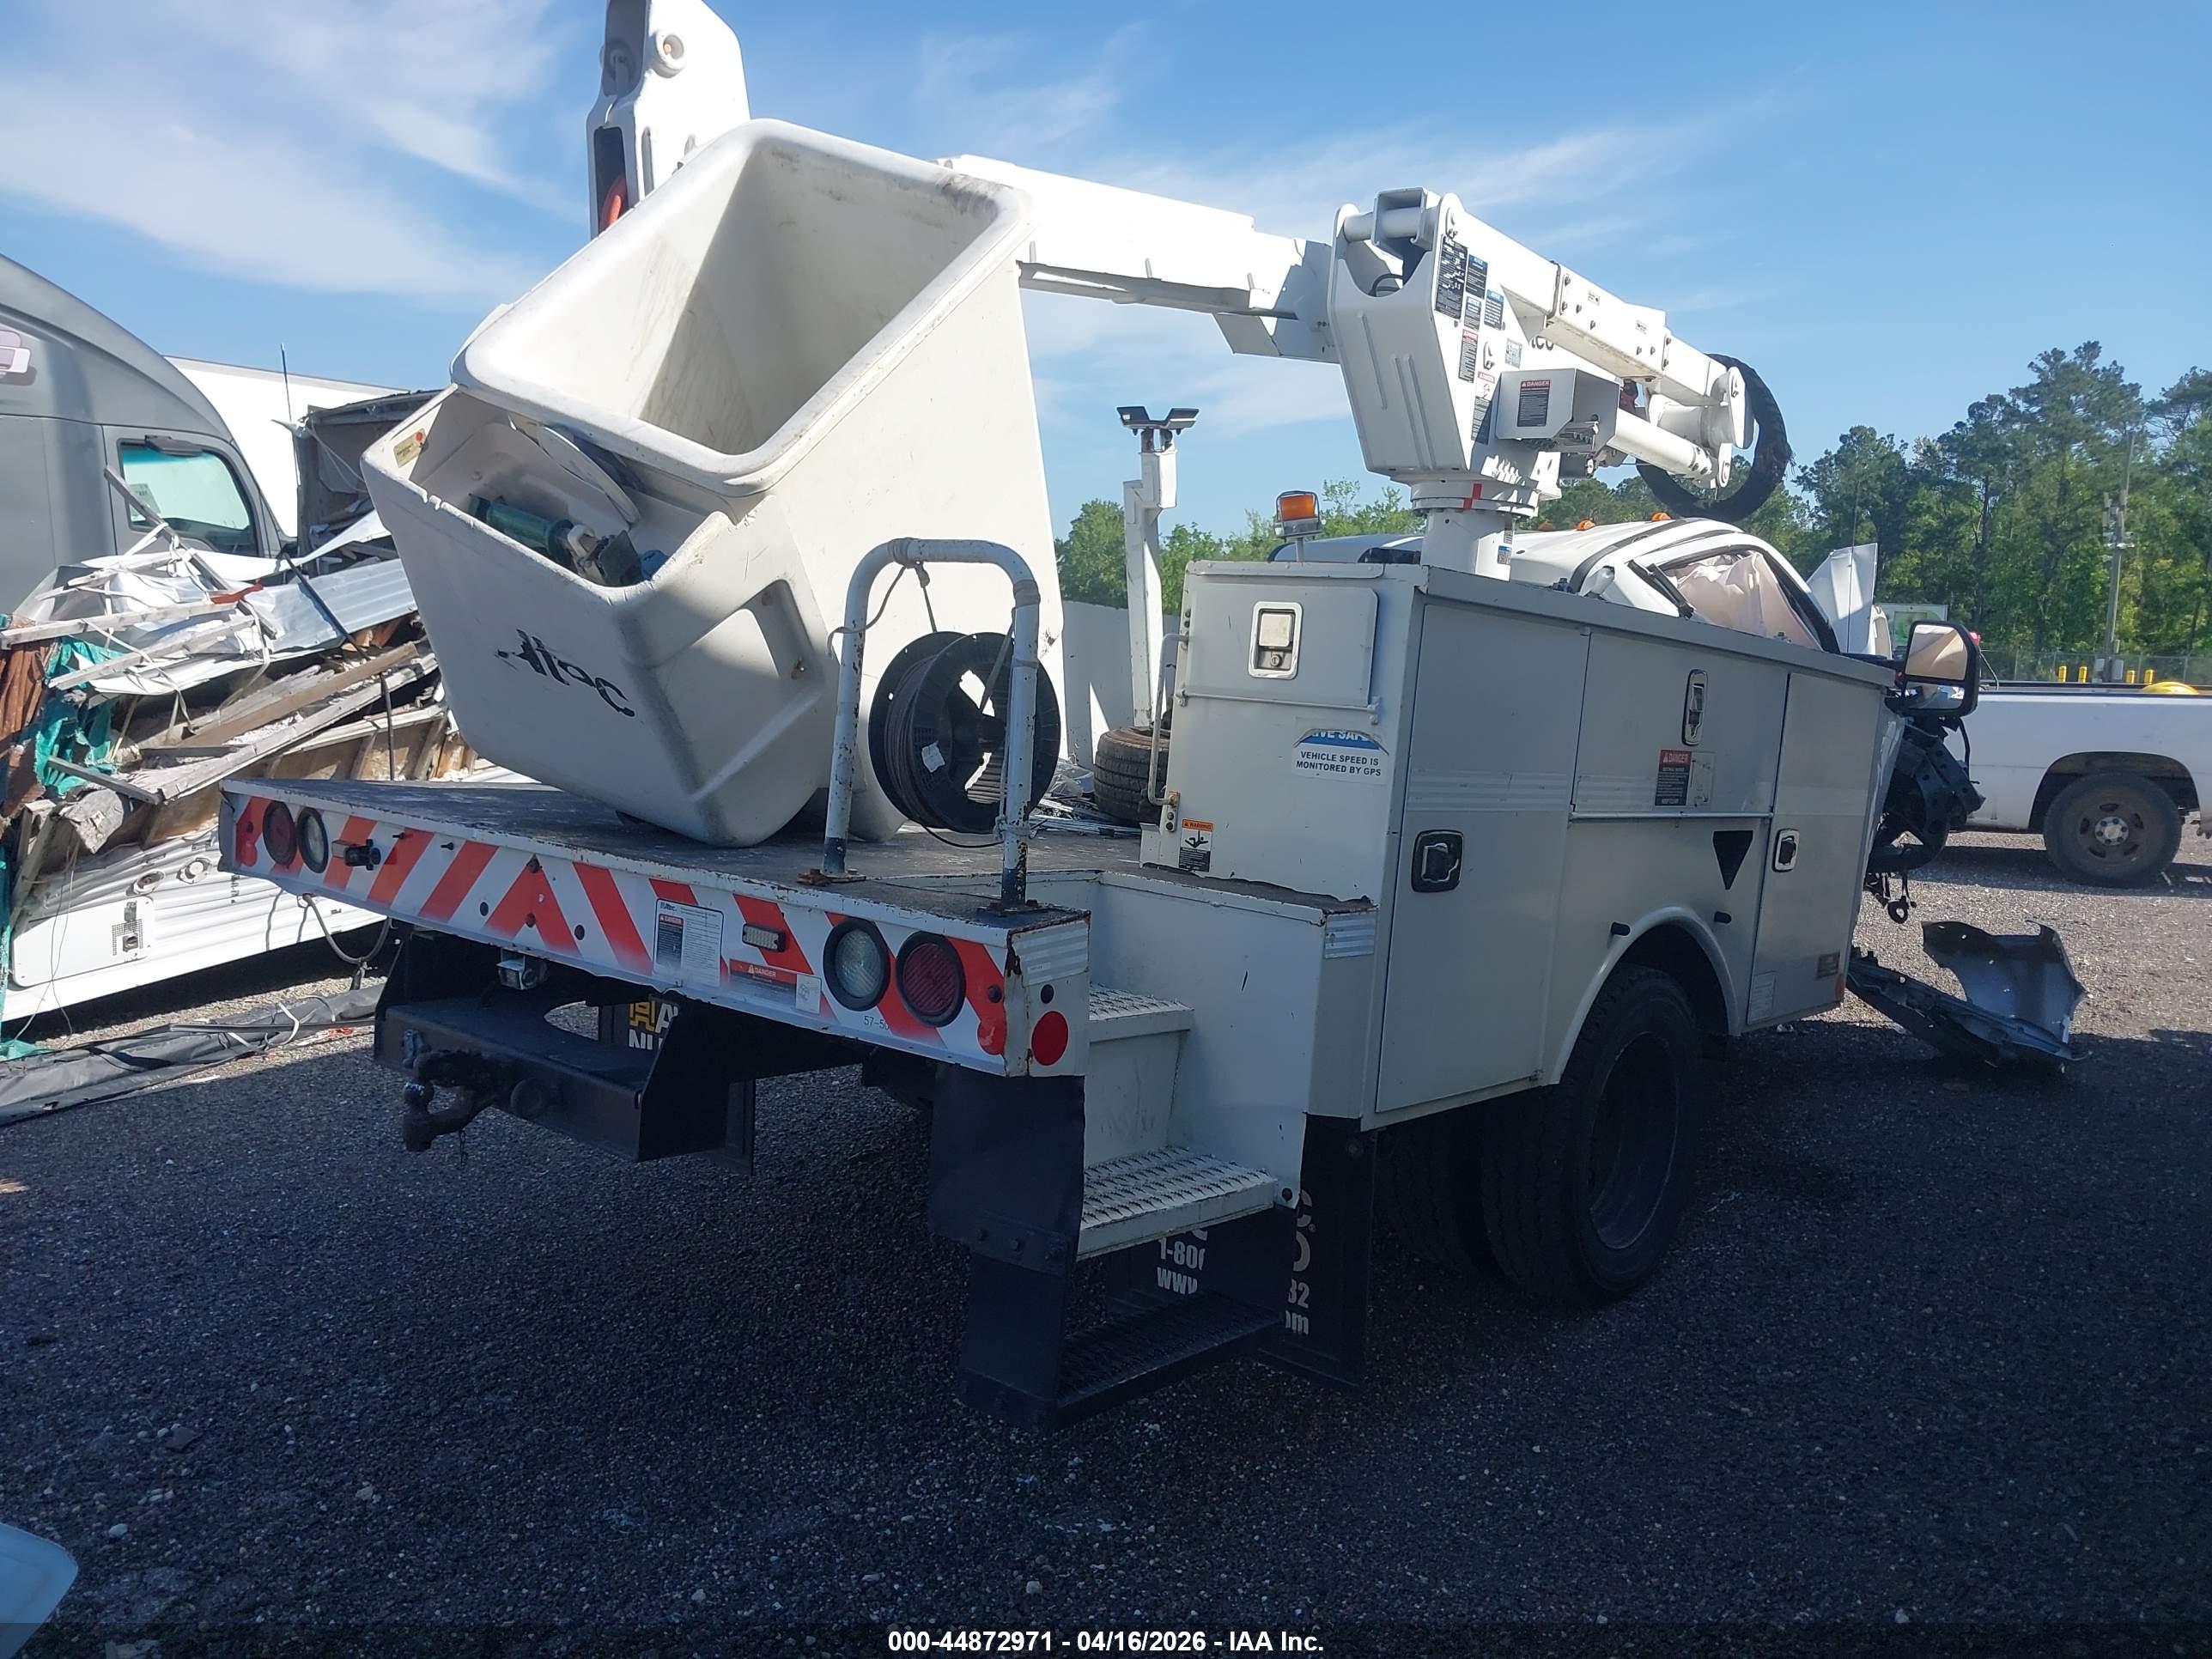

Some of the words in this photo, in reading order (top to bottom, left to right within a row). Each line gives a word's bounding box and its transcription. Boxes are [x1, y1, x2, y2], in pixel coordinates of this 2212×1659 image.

[1300, 750, 1338, 762] VEHICLE
[1339, 755, 1368, 764] SPEED
[1370, 757, 1379, 766] IS
[1296, 761, 1347, 773] MONITORED
[1363, 768, 1382, 776] GPS
[754, 967, 776, 978] DANGER
